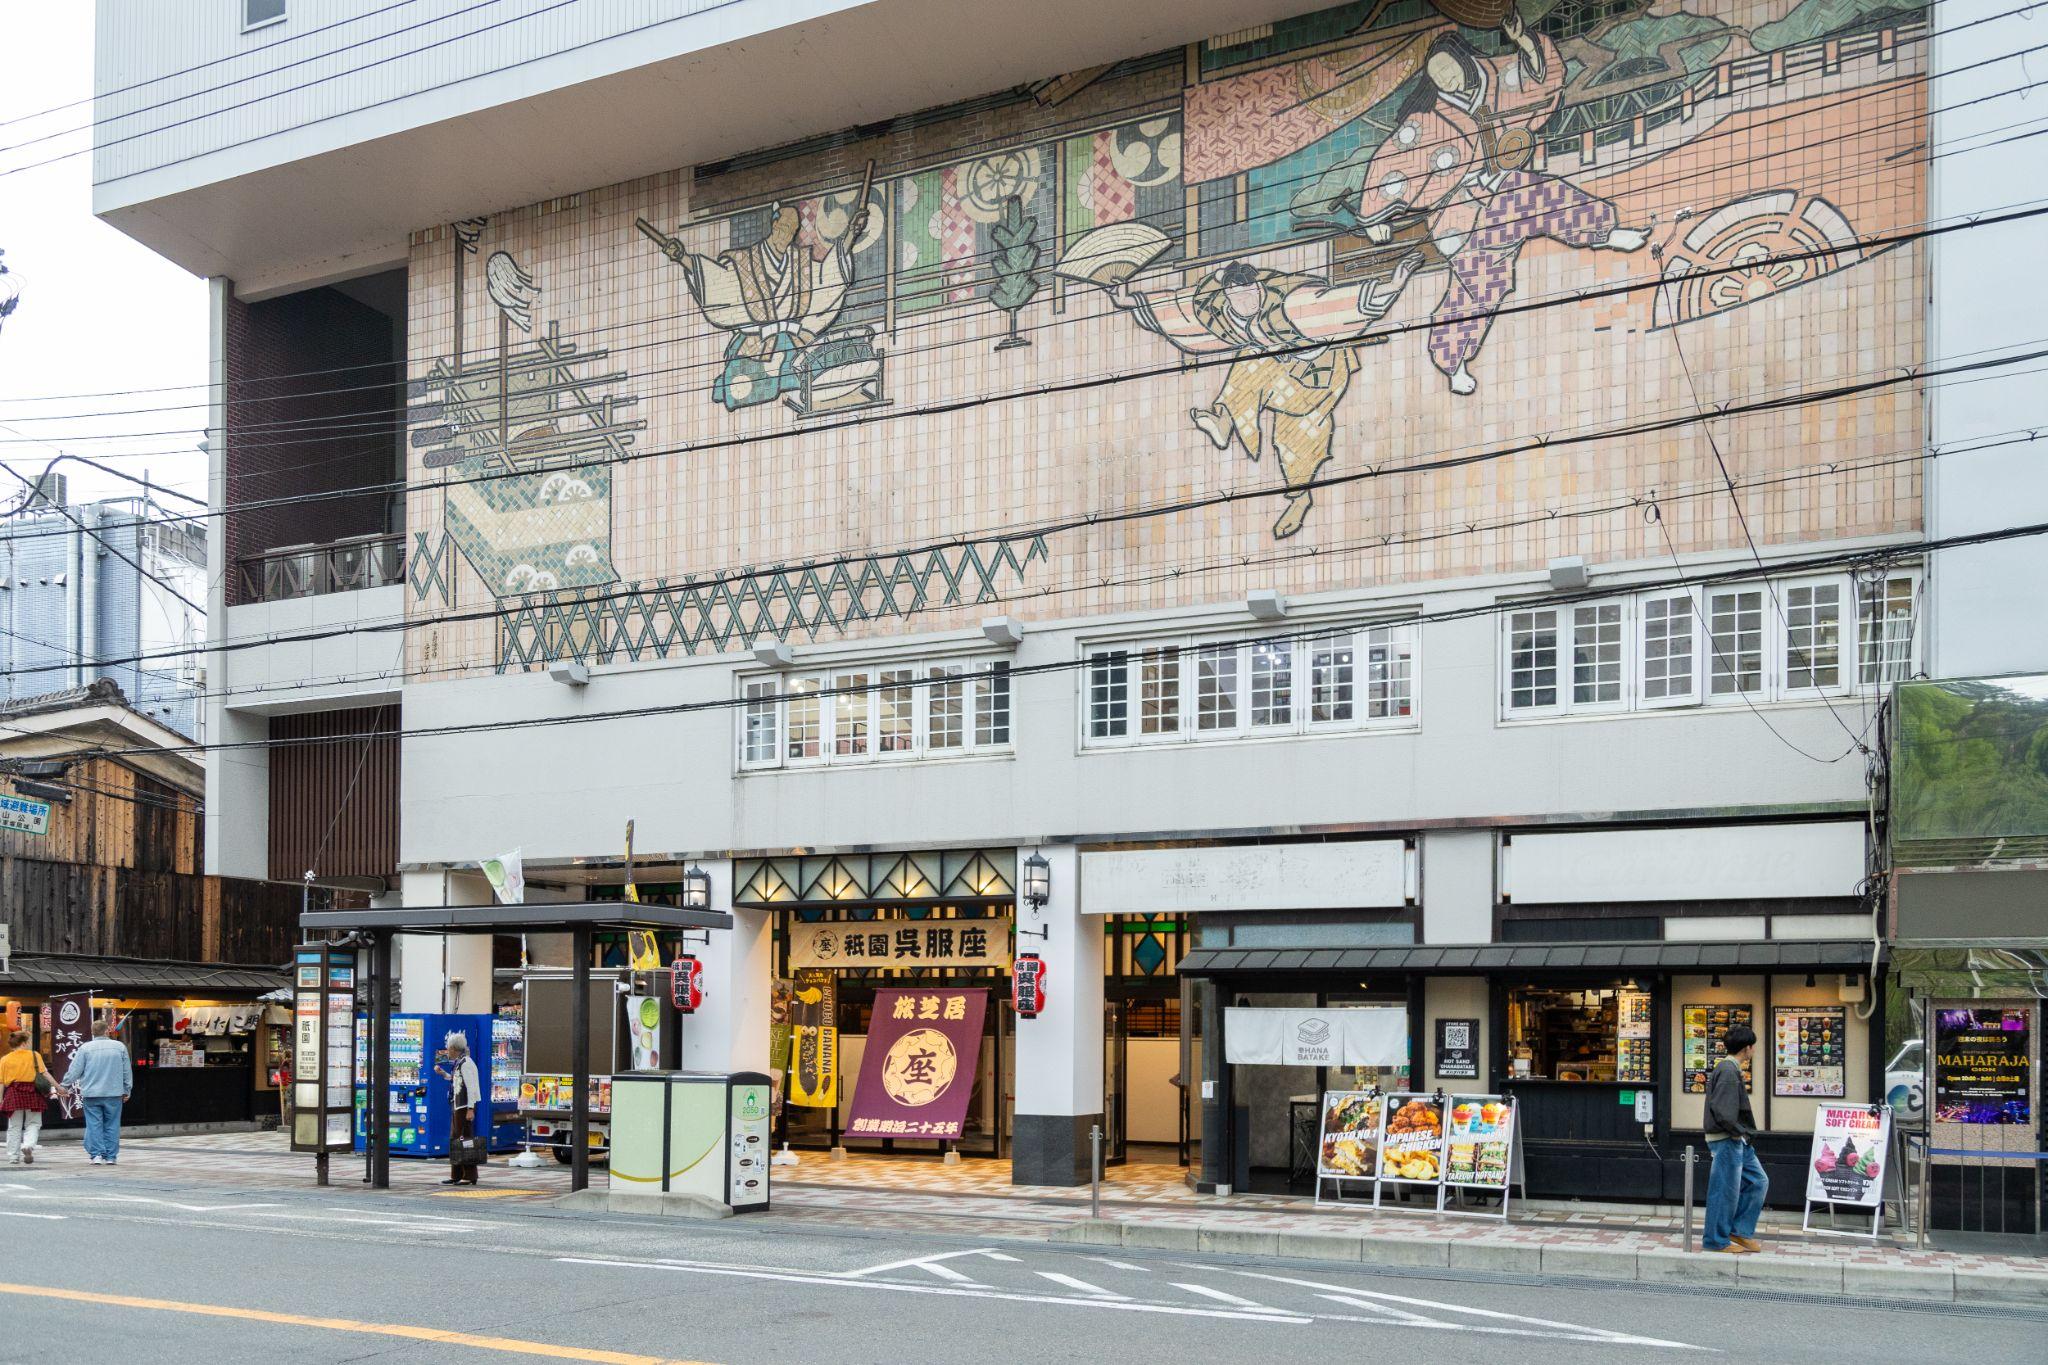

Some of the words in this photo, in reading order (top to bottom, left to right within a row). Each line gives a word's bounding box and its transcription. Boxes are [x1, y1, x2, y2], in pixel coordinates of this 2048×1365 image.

[823, 986, 834, 1026] CHOCO
[892, 995, 967, 1020] 旅芝居
[822, 1029, 833, 1074] BANANA
[1297, 1053, 1330, 1061] BATAKE
[901, 1048, 937, 1085] 座
[1937, 1055, 2030, 1067] MAHARAJA
[1825, 1118, 1847, 1128] SOFT
[1849, 1120, 1880, 1129] CREAM
[1324, 1131, 1356, 1143] KYOTO
[1384, 1129, 1434, 1144] JAPANESE
[1400, 1139, 1443, 1152] CHICKEN
